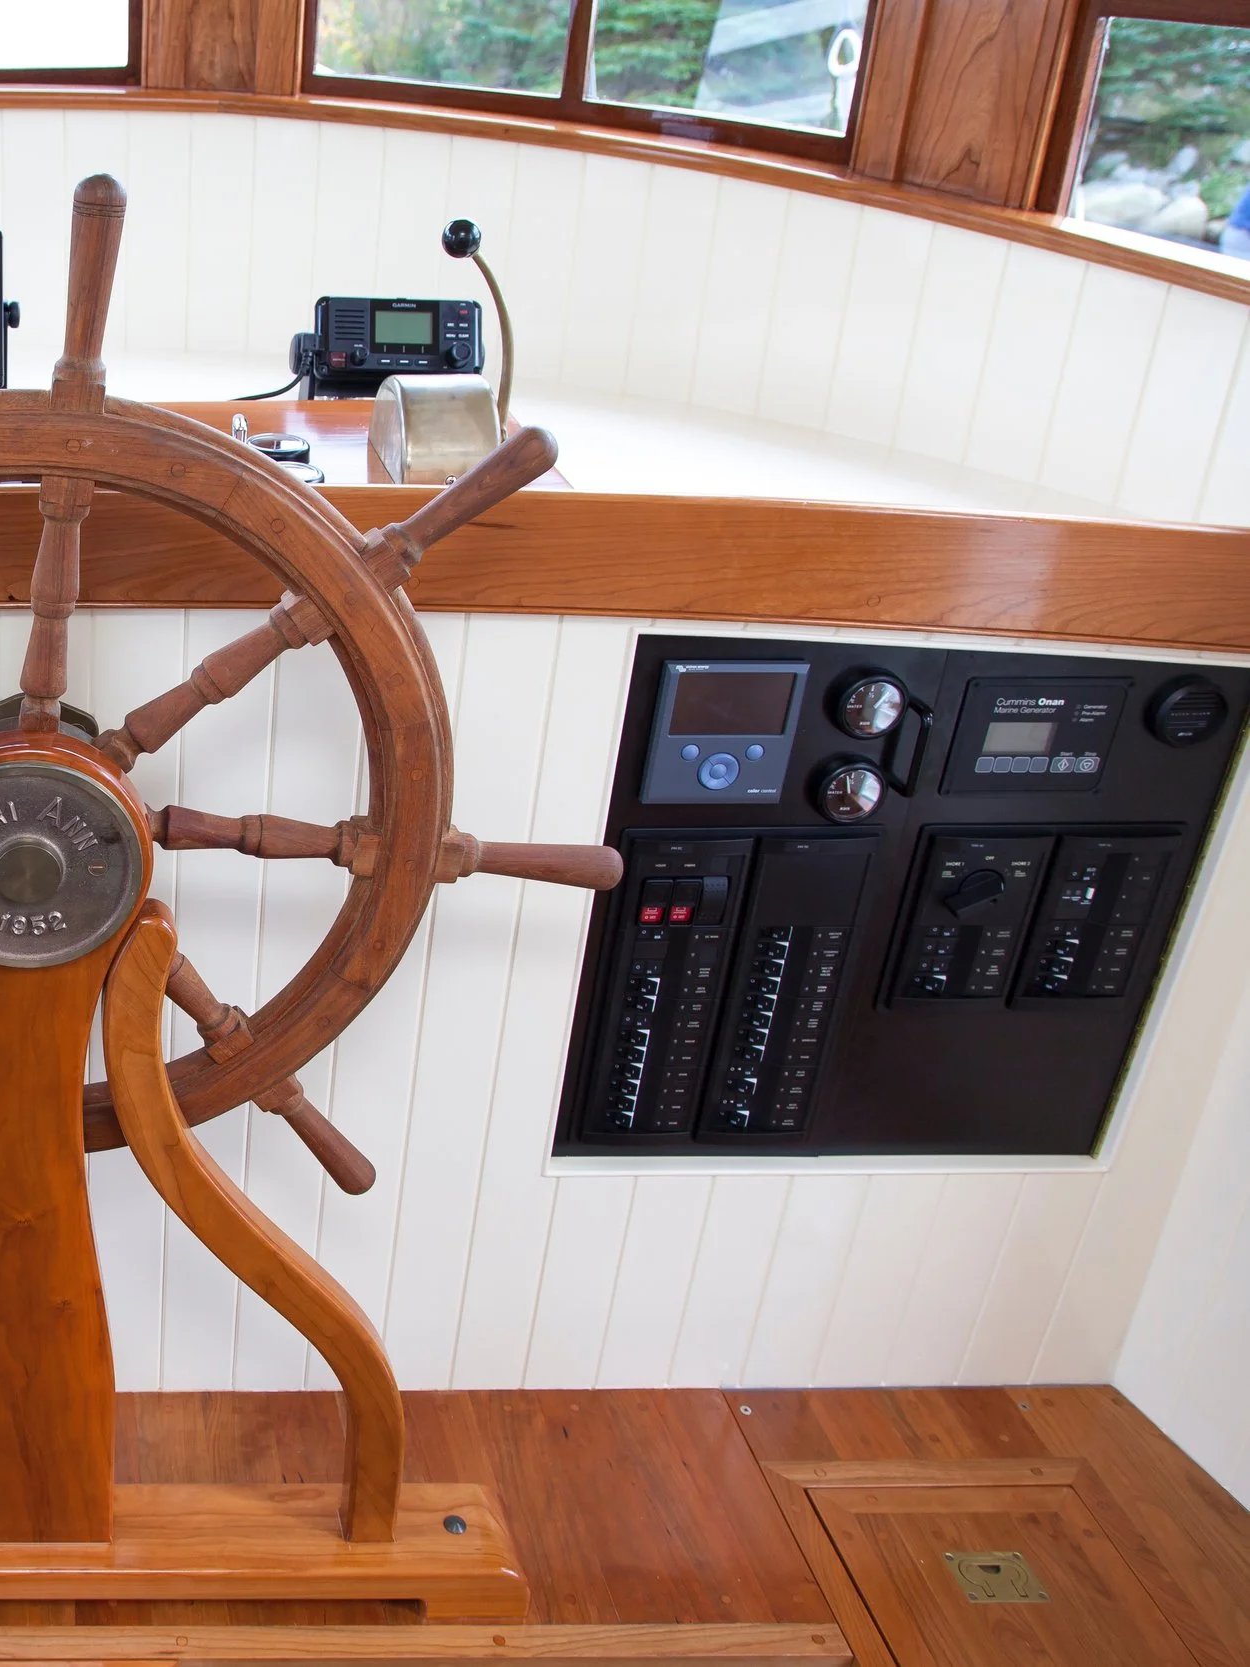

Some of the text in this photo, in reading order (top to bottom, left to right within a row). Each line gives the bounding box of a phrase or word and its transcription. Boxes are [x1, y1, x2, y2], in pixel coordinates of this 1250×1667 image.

[993, 706, 1057, 714] Marine Generator
[996, 697, 1065, 706] Cummins Onan
[36, 796, 99, 851] ANN
[0, 910, 67, 936] 1952
